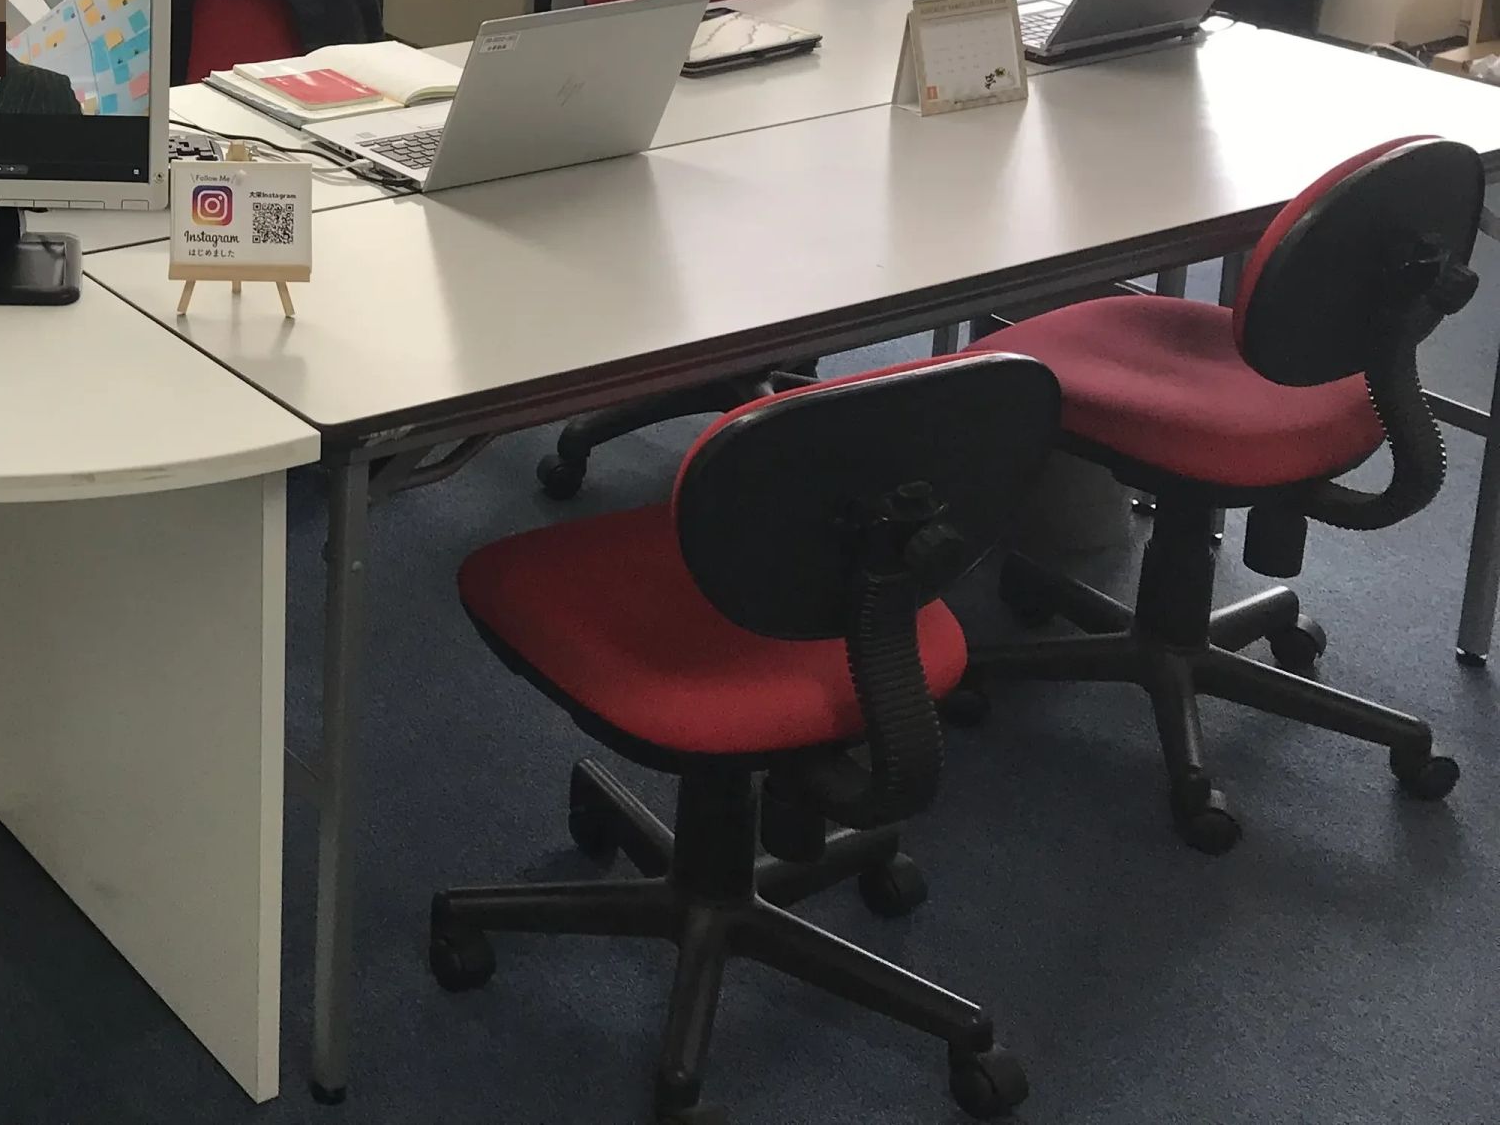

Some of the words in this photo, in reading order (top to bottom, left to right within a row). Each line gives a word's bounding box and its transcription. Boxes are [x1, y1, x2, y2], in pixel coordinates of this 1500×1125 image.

[183, 230, 240, 248] Instagram
[188, 249, 236, 258] はじめました
